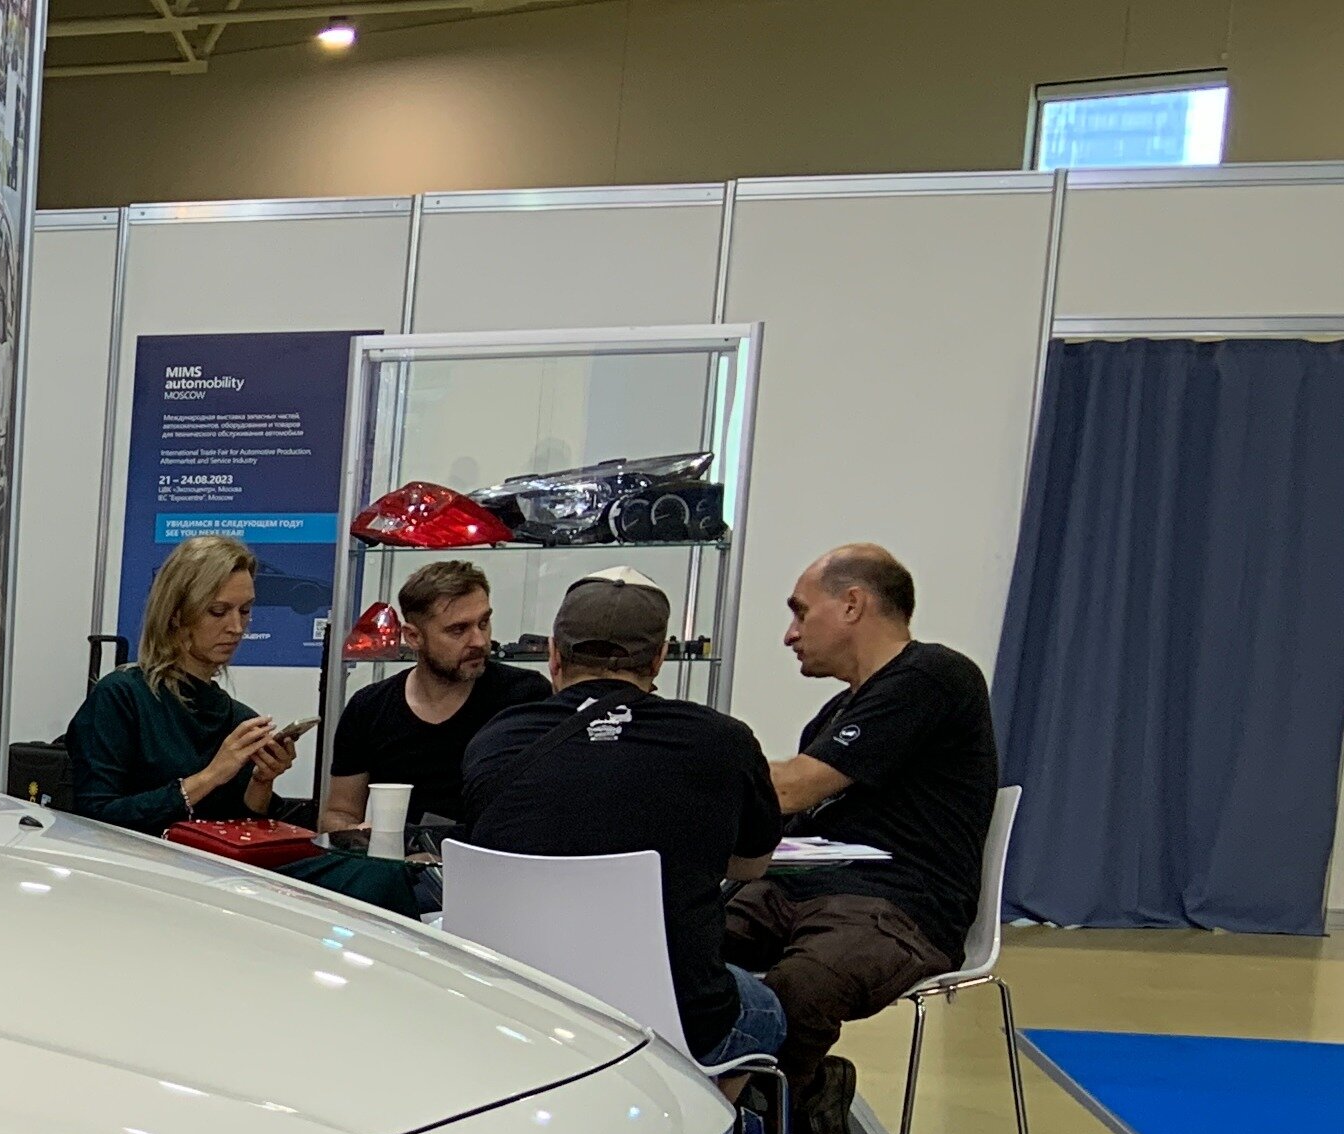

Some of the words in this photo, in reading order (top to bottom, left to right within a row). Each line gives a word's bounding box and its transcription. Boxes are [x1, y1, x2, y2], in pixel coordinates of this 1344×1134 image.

[166, 366, 202, 378] MIMS
[165, 376, 245, 391] automobility
[164, 391, 206, 400] MOSCOW
[159, 475, 170, 485] 21
[180, 474, 234, 485] 24.08.2023
